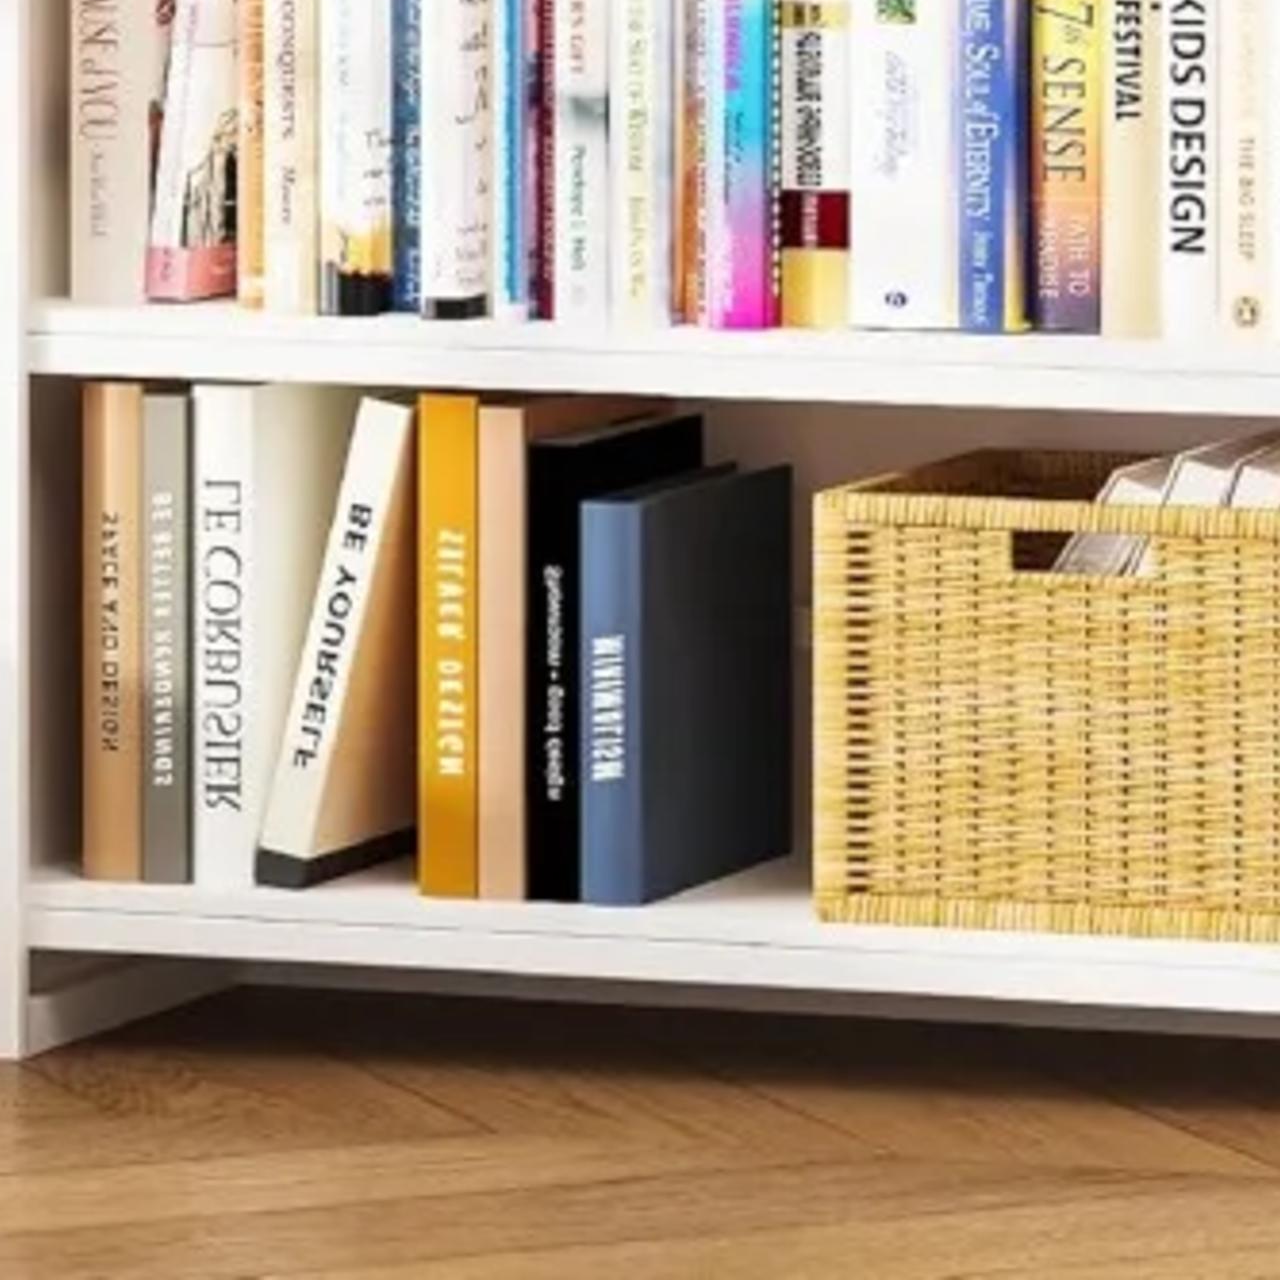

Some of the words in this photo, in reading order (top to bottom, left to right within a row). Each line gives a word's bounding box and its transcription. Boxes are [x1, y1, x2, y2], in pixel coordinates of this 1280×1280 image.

[1041, 55, 1087, 184] SENSE
[1238, 136, 1254, 170] THE
[1169, 97, 1206, 255] DESIGN
[1238, 212, 1254, 262] SLEEP
